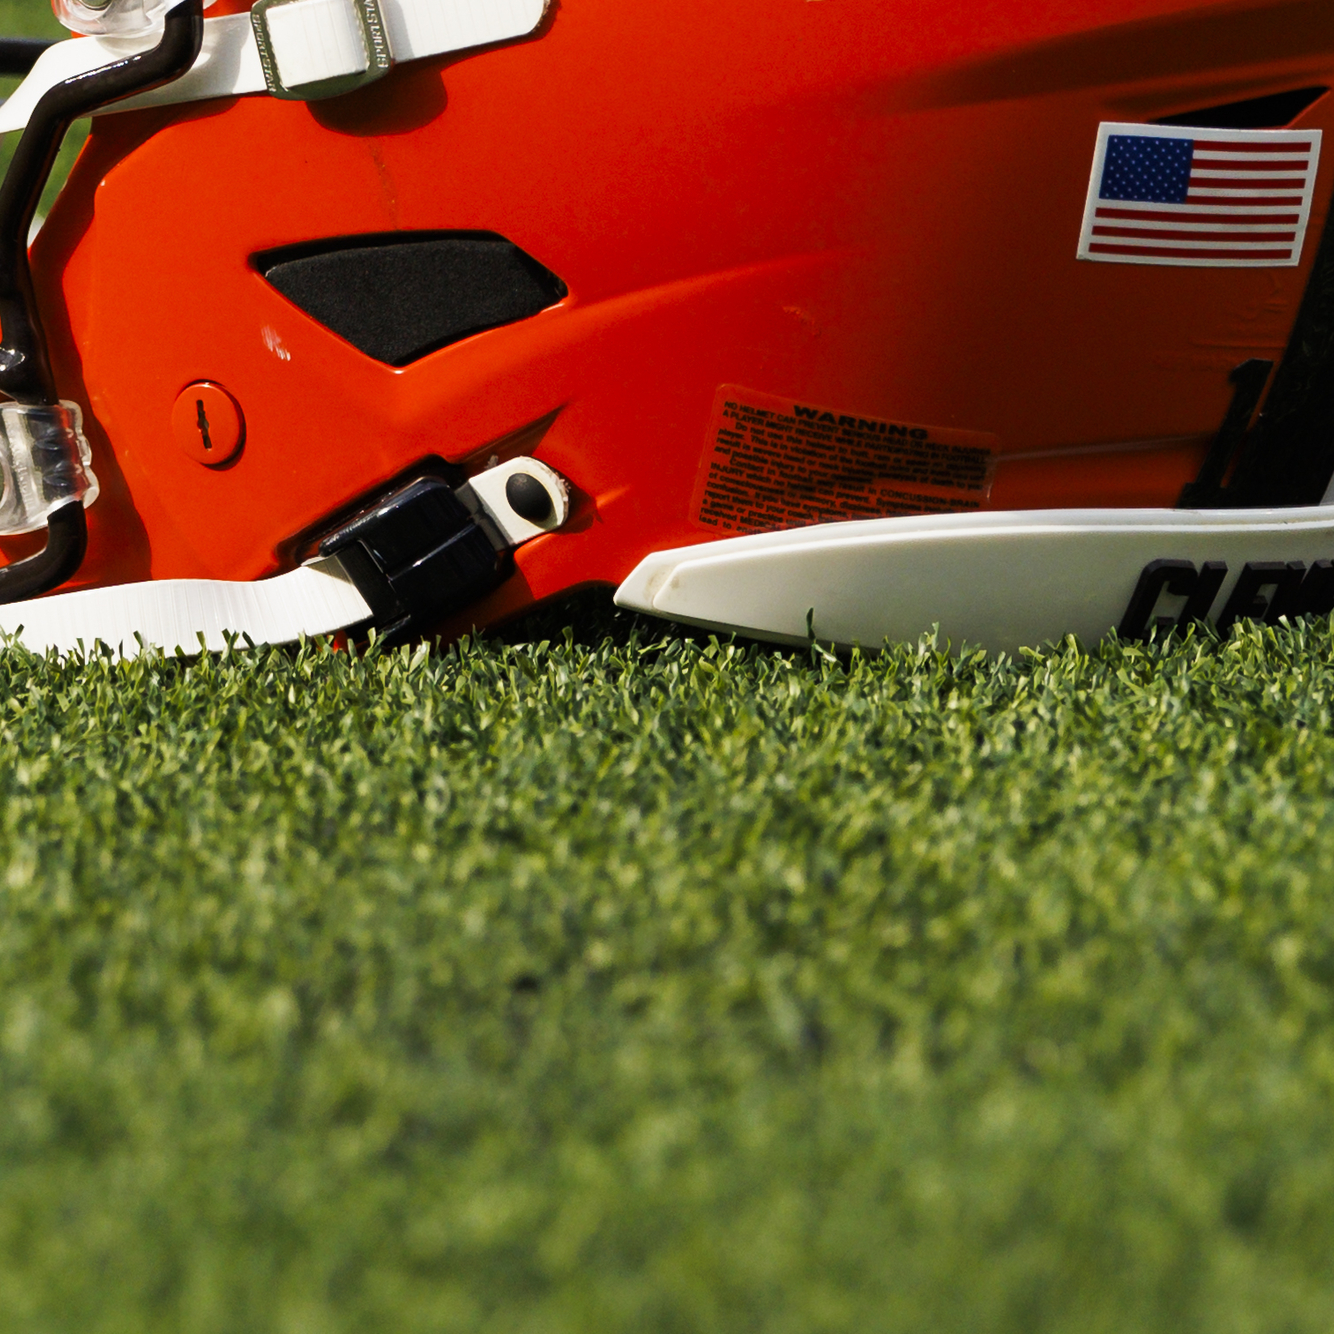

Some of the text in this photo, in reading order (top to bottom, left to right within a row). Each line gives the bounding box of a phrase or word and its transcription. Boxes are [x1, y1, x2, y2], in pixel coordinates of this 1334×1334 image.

[252, 13, 277, 93] SPORTSTAR
[729, 411, 764, 425] PLAYER
[739, 405, 775, 418] HELMET
[776, 413, 796, 424] CAN
[797, 418, 839, 433] PREVENT
[794, 405, 927, 439] WARNING
[749, 426, 765, 435] not
[786, 435, 802, 444] this
[750, 434, 768, 446] This
[710, 462, 743, 476] INJURY
